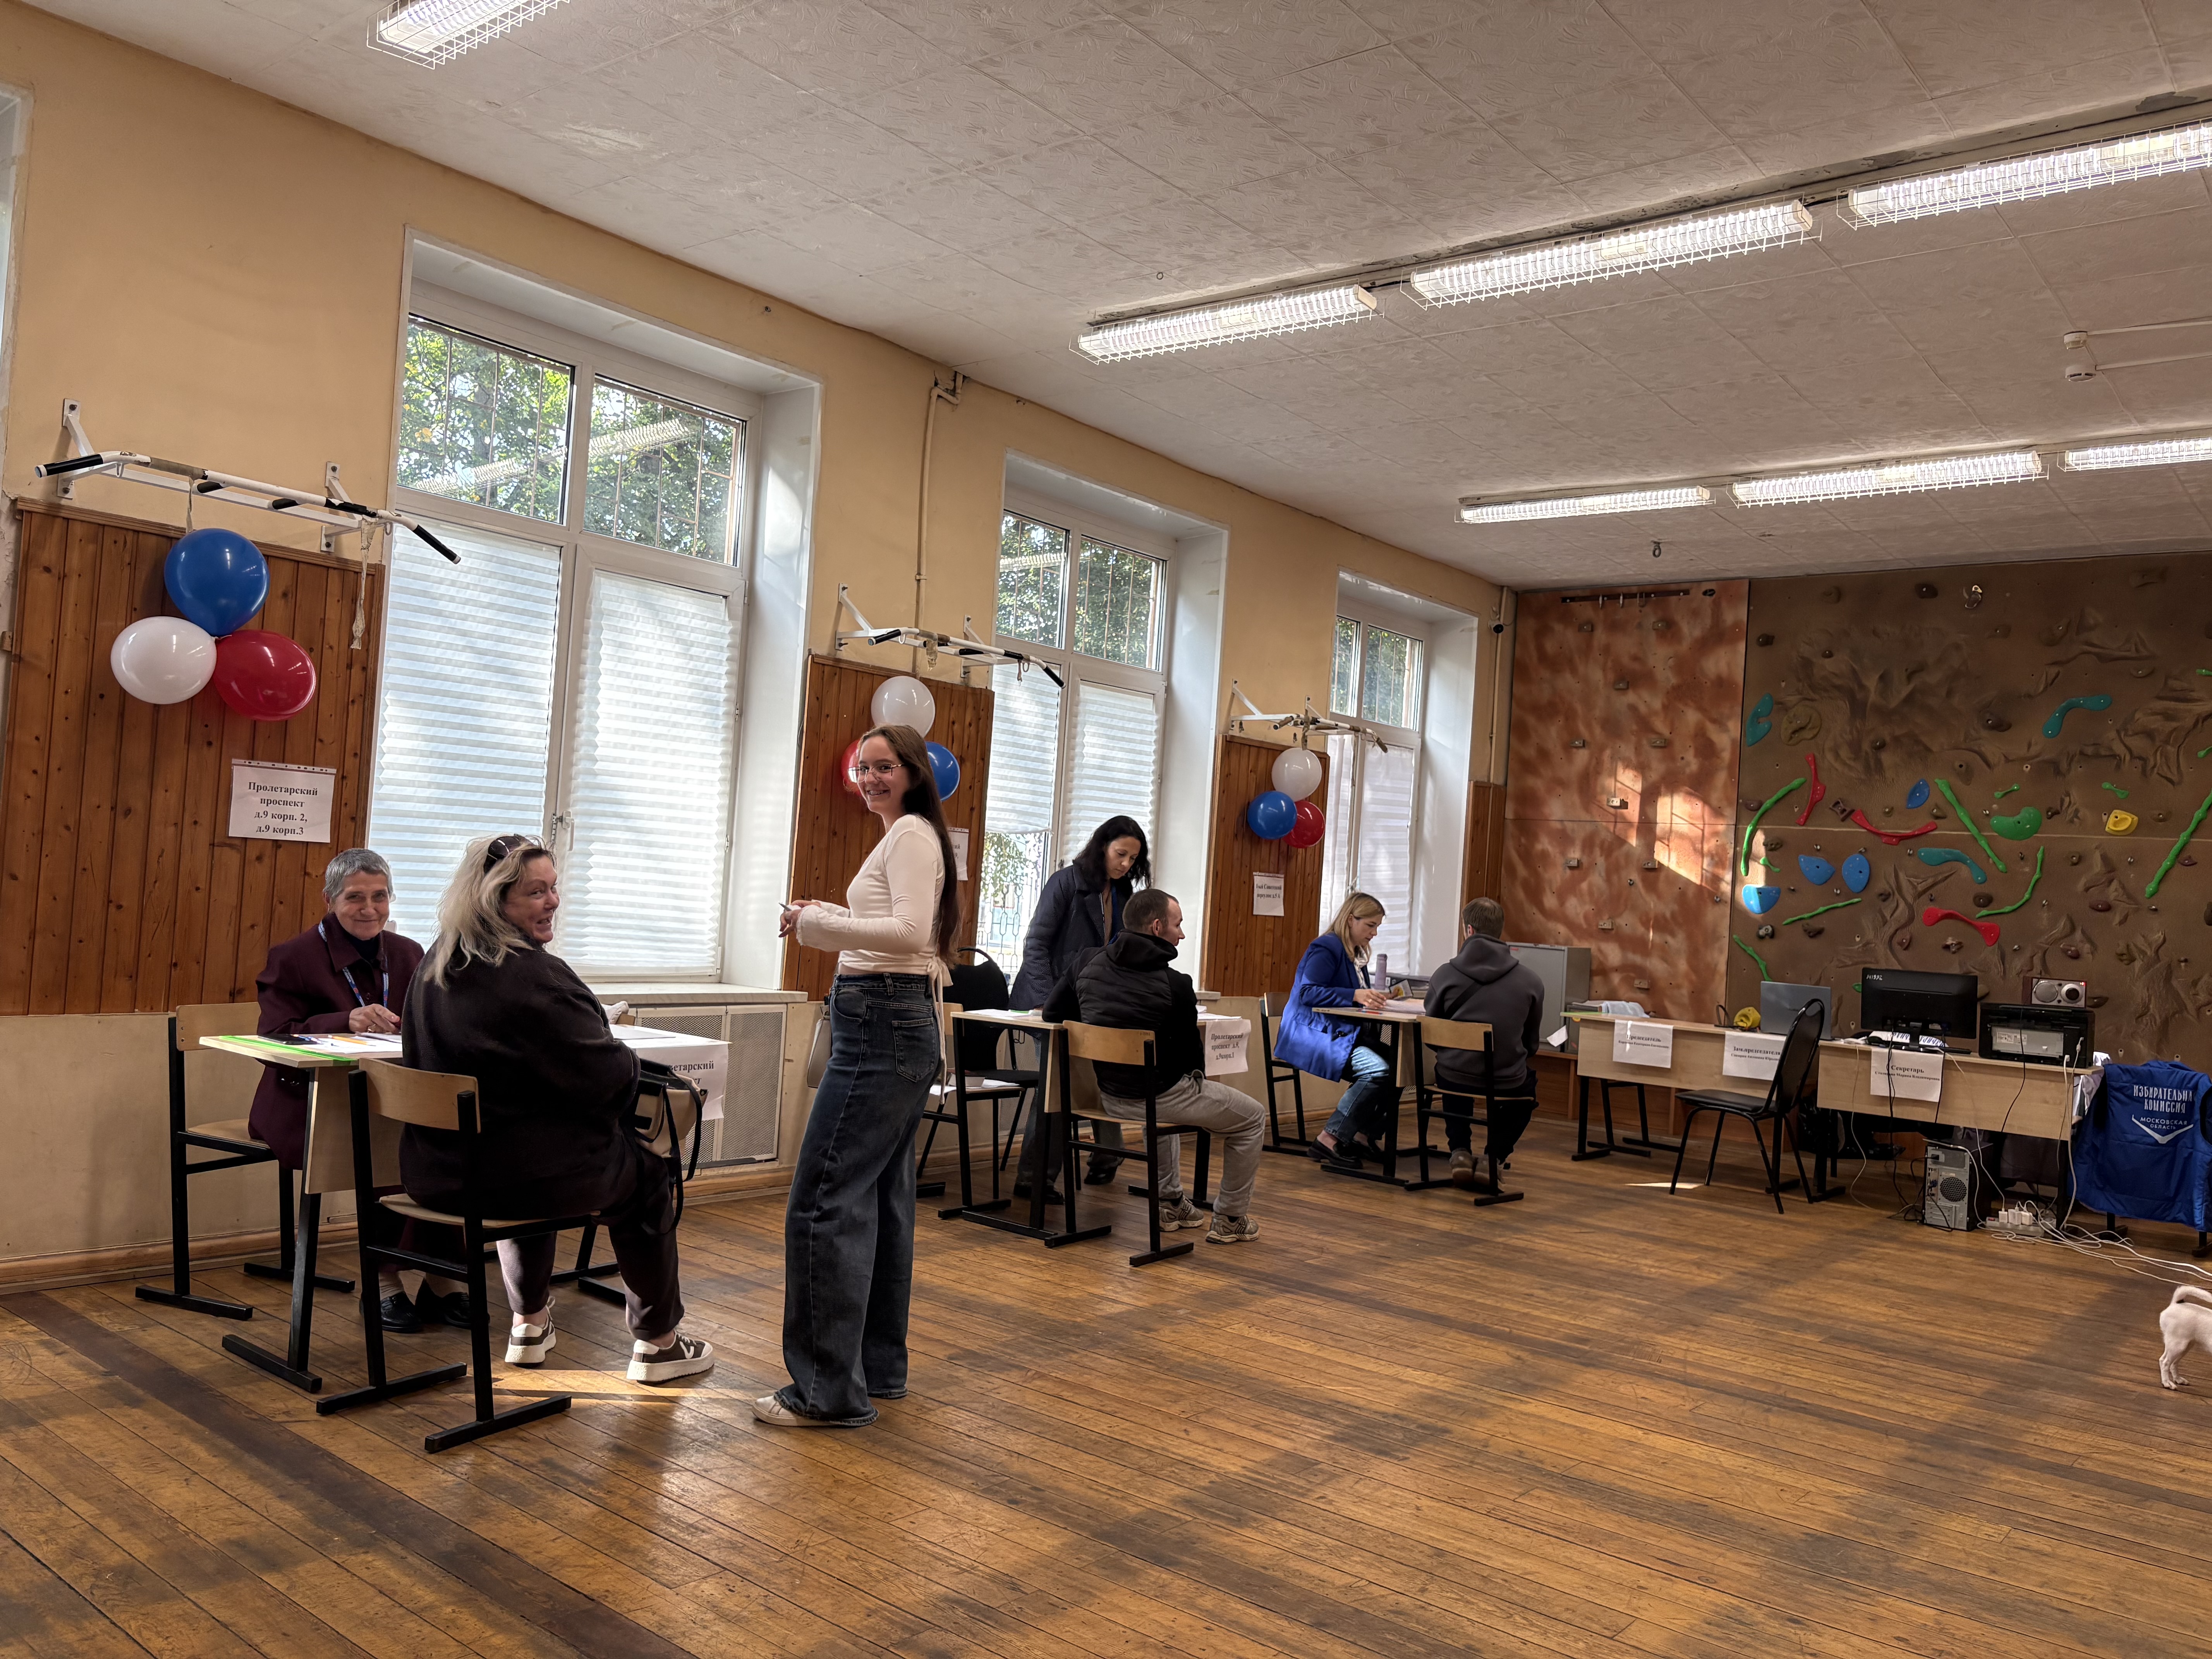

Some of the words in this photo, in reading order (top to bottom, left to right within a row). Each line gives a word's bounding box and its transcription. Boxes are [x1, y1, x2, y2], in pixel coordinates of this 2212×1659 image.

[249, 782, 318, 795] Пролетарский
[260, 798, 305, 807] проспект
[254, 810, 268, 818] д.9
[271, 813, 297, 821] корп.
[300, 814, 307, 823] 2,
[256, 824, 270, 833] д.9
[273, 827, 304, 836] корп.3
[1211, 1033, 1243, 1041] Пролетарский
[670, 1060, 714, 1073] етарский
[1891, 1065, 1924, 1073] Секретарь
[2133, 1085, 2195, 1102] ИЗБИРАТЕЛЬНА
[2144, 1099, 2186, 1113] КОМИССИЯ
[2140, 1117, 2187, 1125] МОСКОВСКАЯ
